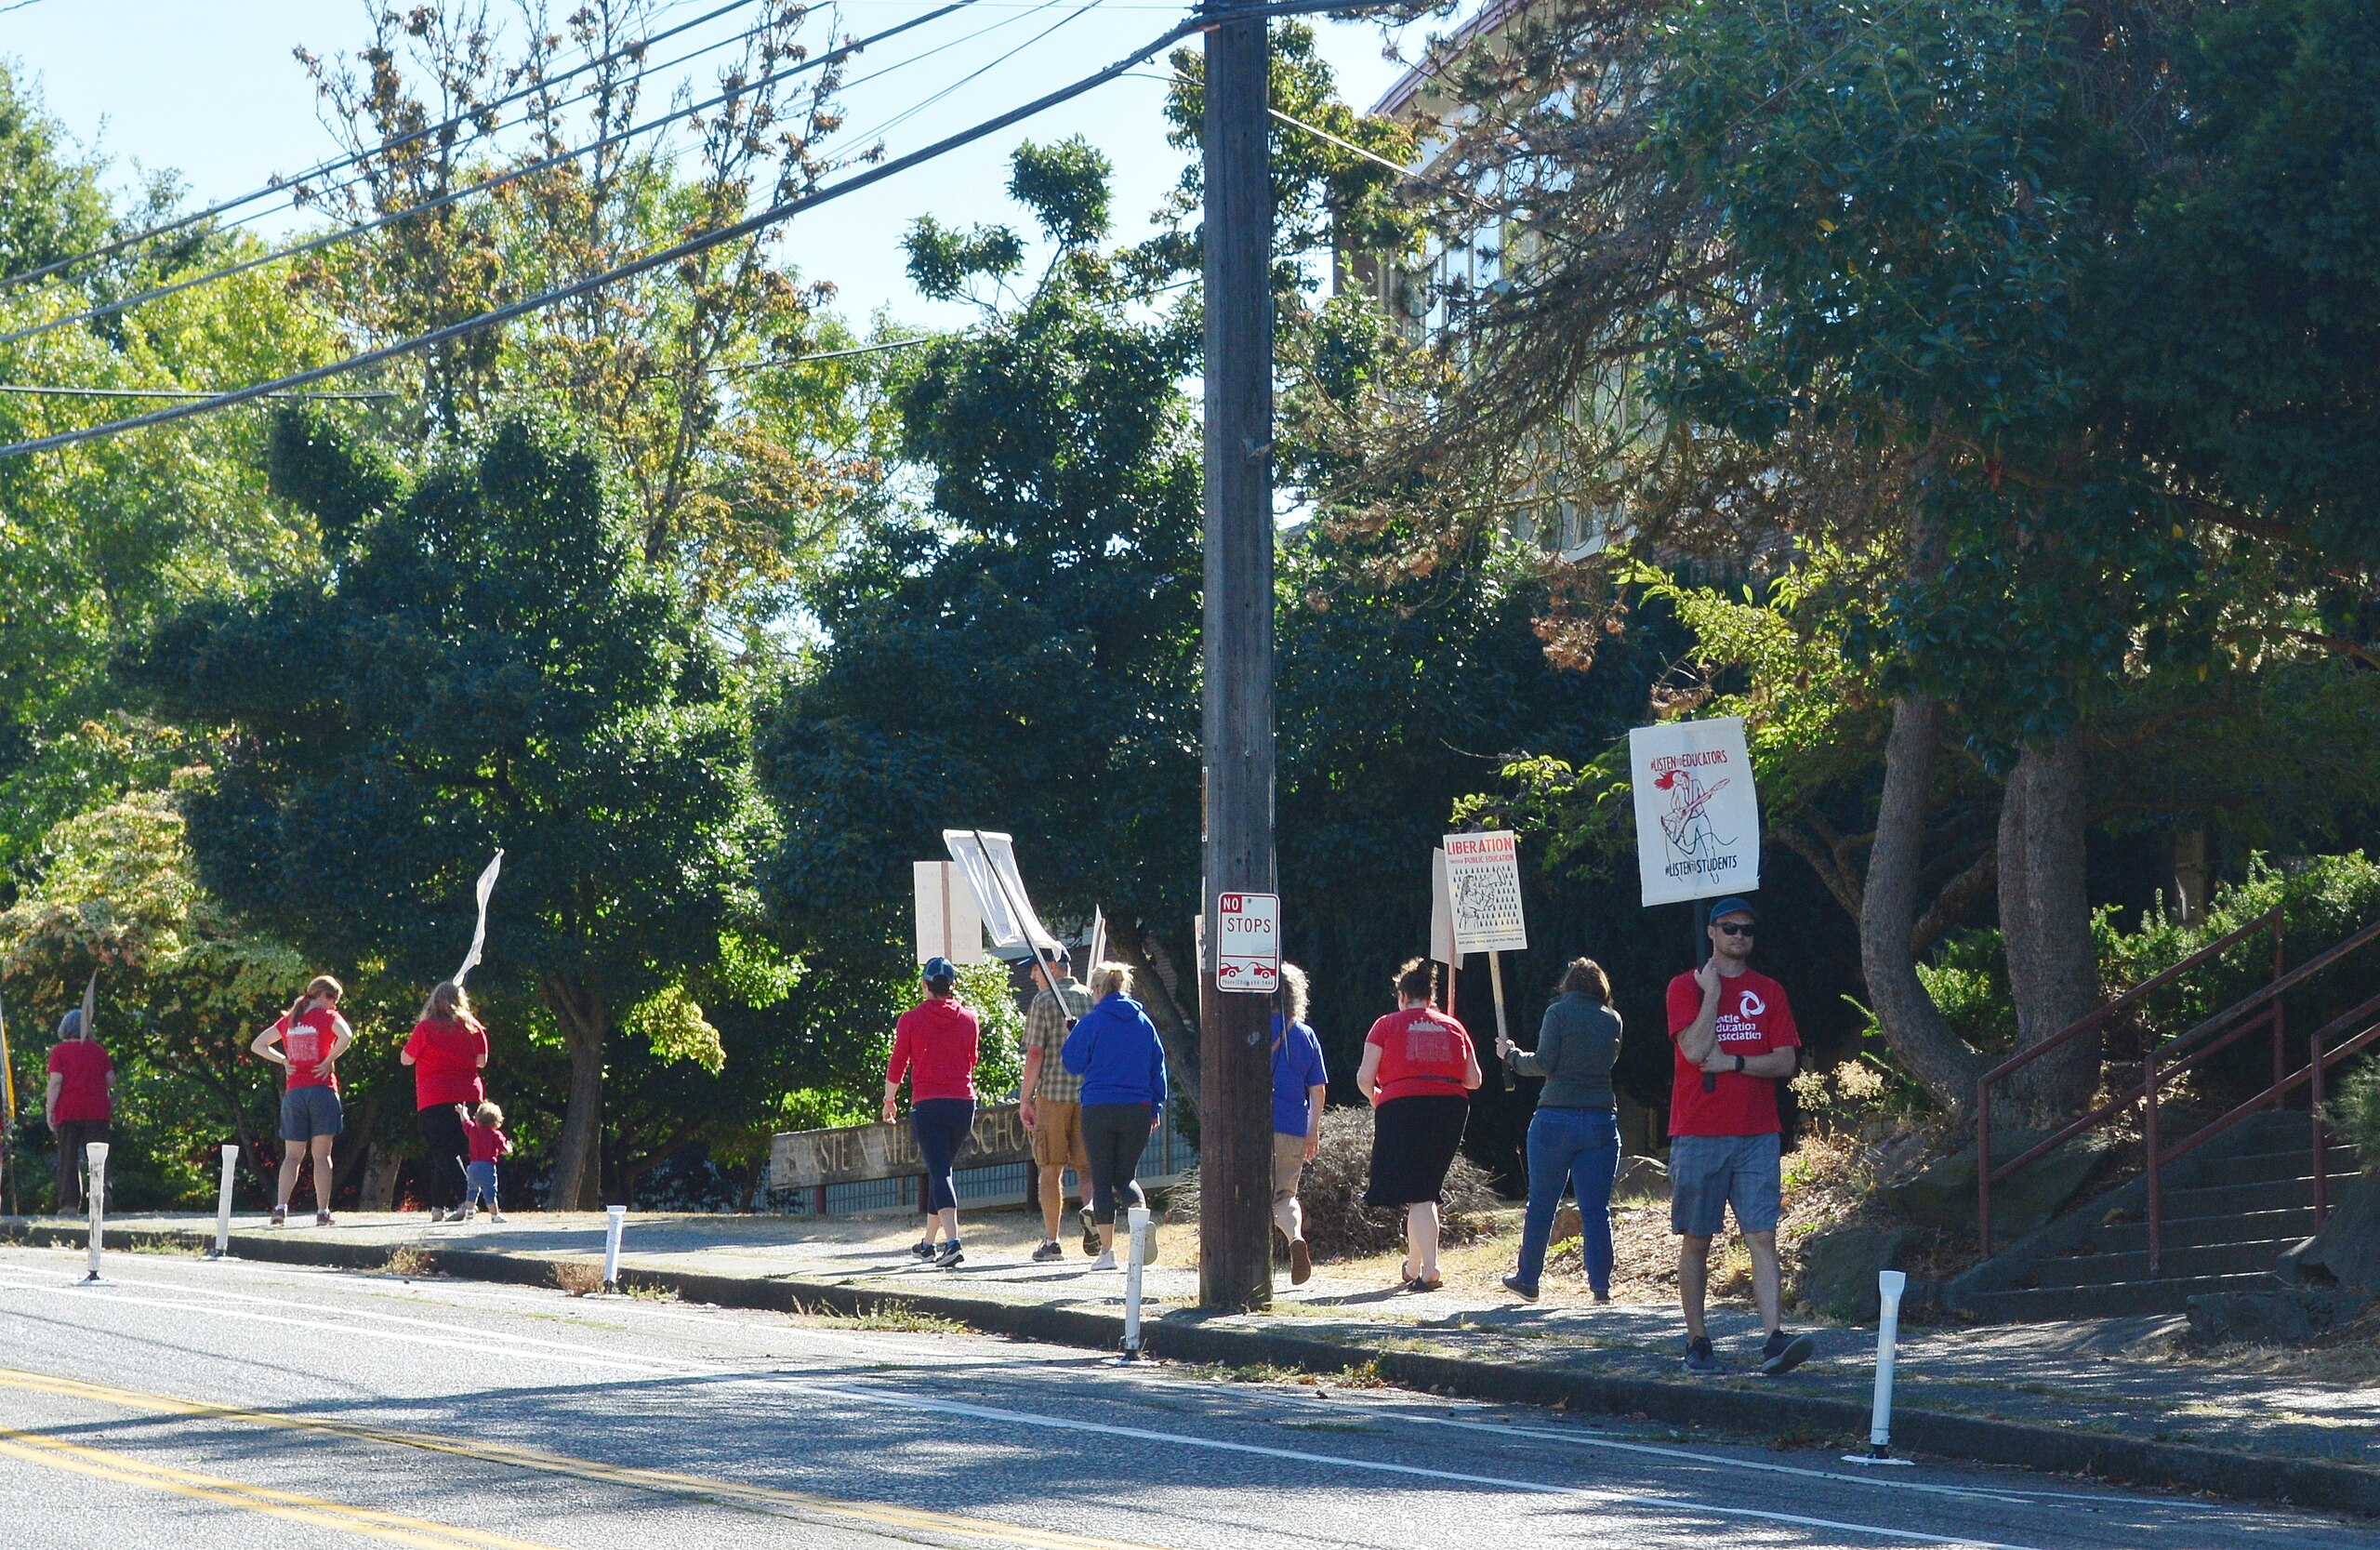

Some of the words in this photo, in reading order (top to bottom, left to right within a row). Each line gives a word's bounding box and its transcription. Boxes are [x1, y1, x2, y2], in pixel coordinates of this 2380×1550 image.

[1447, 838, 1513, 855] LIBERATION
[1223, 897, 1239, 910] NO
[1227, 918, 1271, 934] STOPS
[1715, 1022, 1756, 1032] ducation
[1717, 1031, 1761, 1041] ssociation
